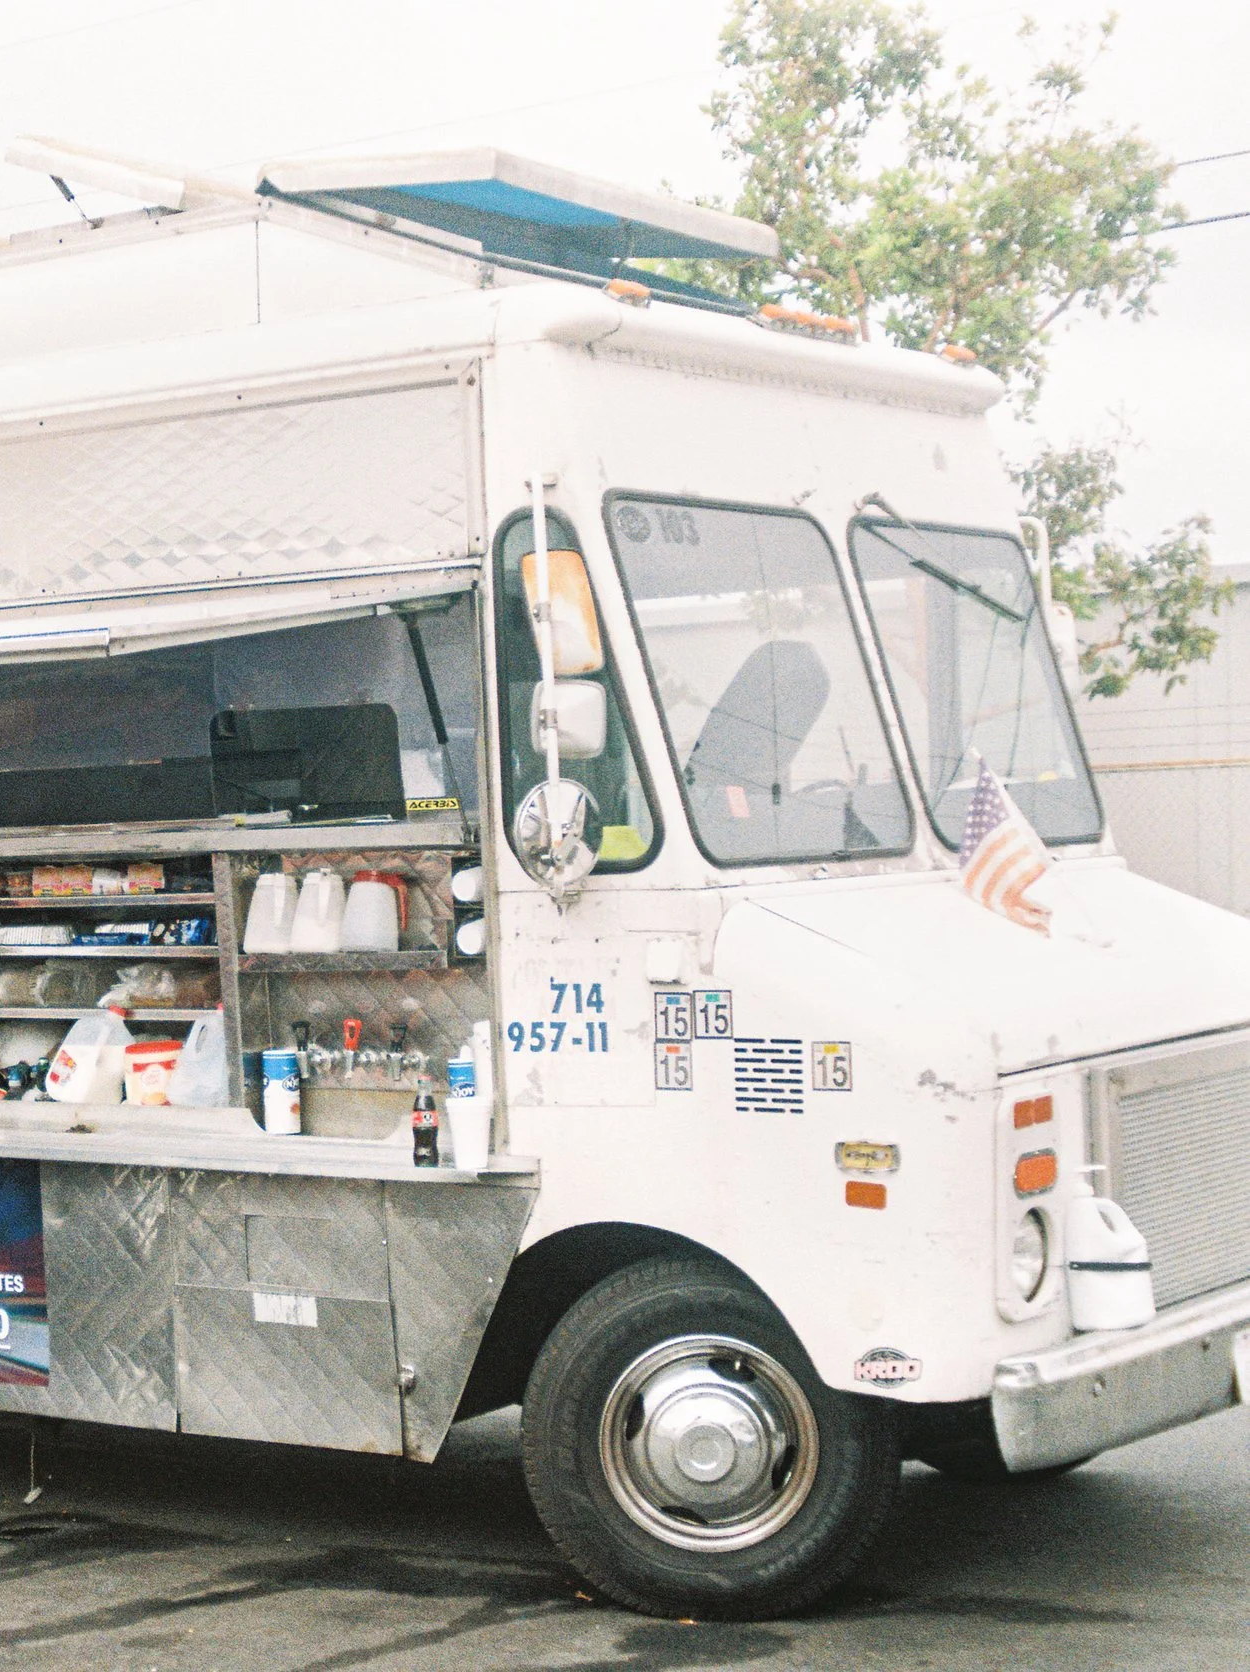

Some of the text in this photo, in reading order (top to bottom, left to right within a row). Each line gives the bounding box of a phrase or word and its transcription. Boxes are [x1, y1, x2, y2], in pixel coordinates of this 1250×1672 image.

[551, 983, 605, 1014] 714
[659, 1006, 689, 1037] 15
[700, 1004, 730, 1035] 15
[507, 1021, 609, 1052] 957-11
[660, 1055, 690, 1087] 15
[817, 1055, 848, 1087] 15
